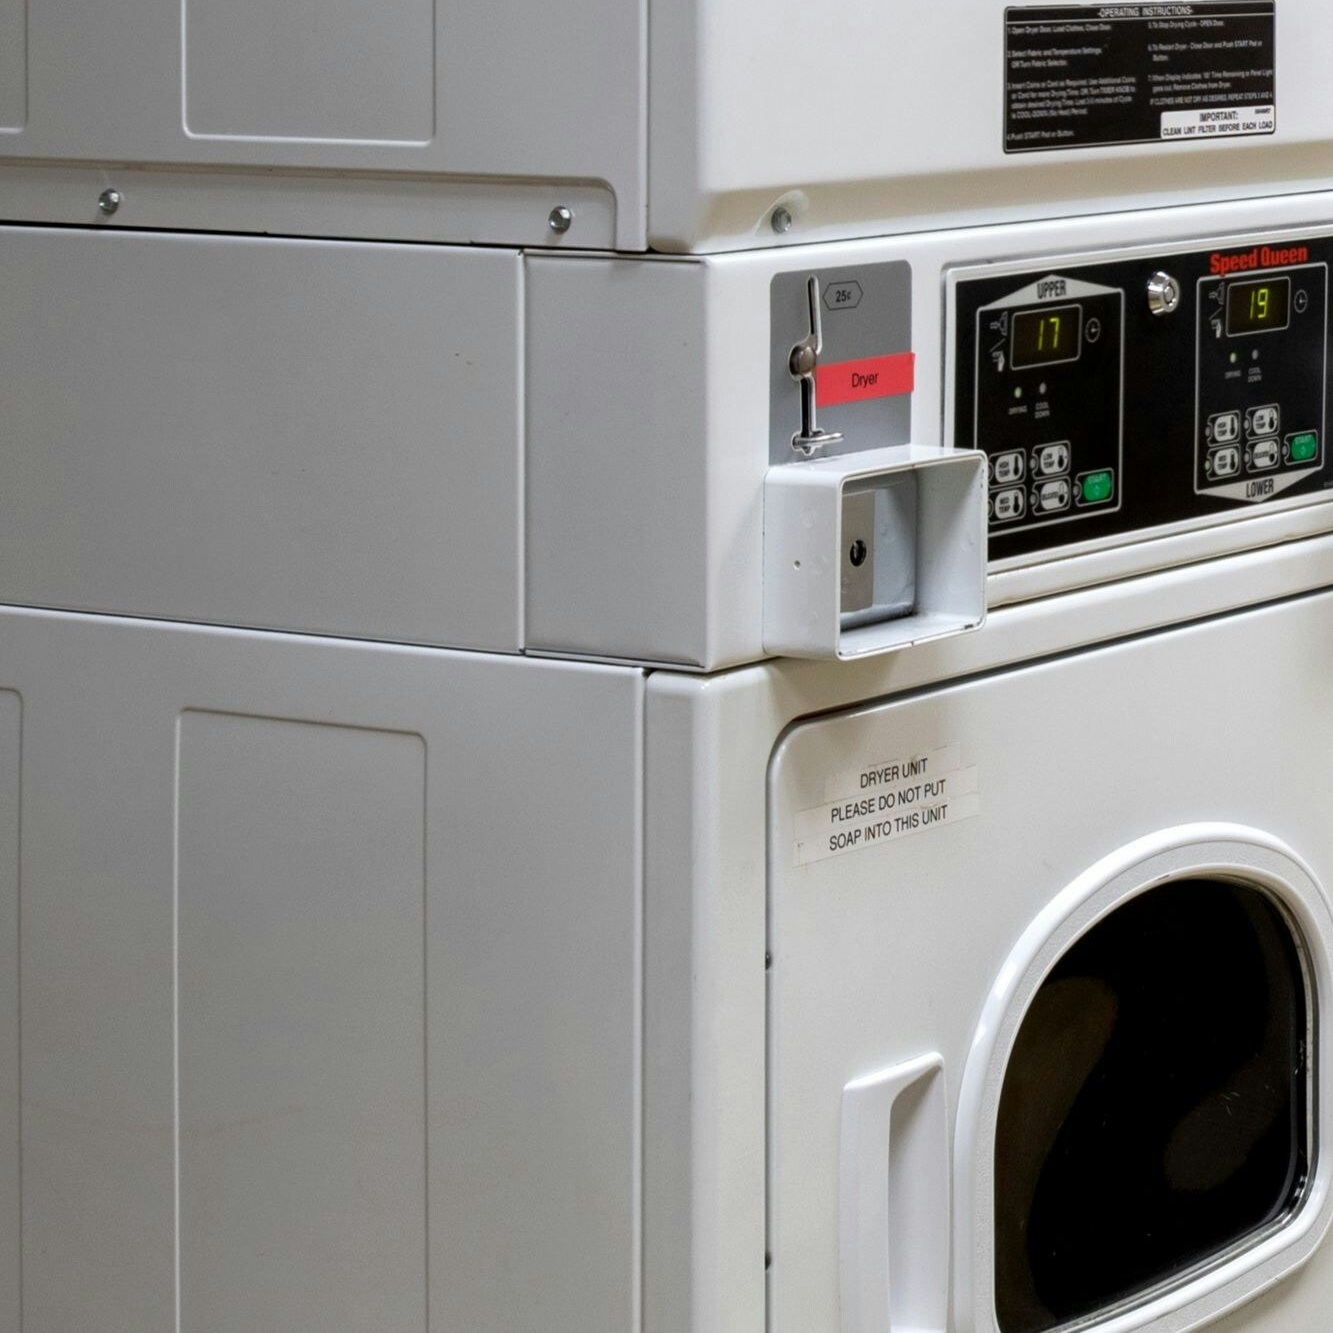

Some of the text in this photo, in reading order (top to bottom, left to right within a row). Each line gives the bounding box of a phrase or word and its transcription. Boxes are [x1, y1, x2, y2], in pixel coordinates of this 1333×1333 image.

[1163, 127, 1181, 135] CLEAN
[1183, 126, 1195, 134] LINT
[1198, 124, 1215, 133] FILTER
[1218, 123, 1239, 131] BEFORE
[1258, 120, 1272, 128] LOAD
[1199, 111, 1238, 121] IMPORTANT:
[1210, 246, 1307, 277] Speed Queen
[1037, 279, 1067, 299] UPPER
[1249, 288, 1269, 319] 19
[1038, 317, 1059, 351] 17
[851, 372, 879, 388] Dryer
[1246, 478, 1274, 498] LOWER
[860, 758, 928, 788] DRYER UNIT
[831, 779, 946, 823] PLEASE DO NOT PUT
[829, 804, 948, 851] SOAP INTO THIS UNIT
